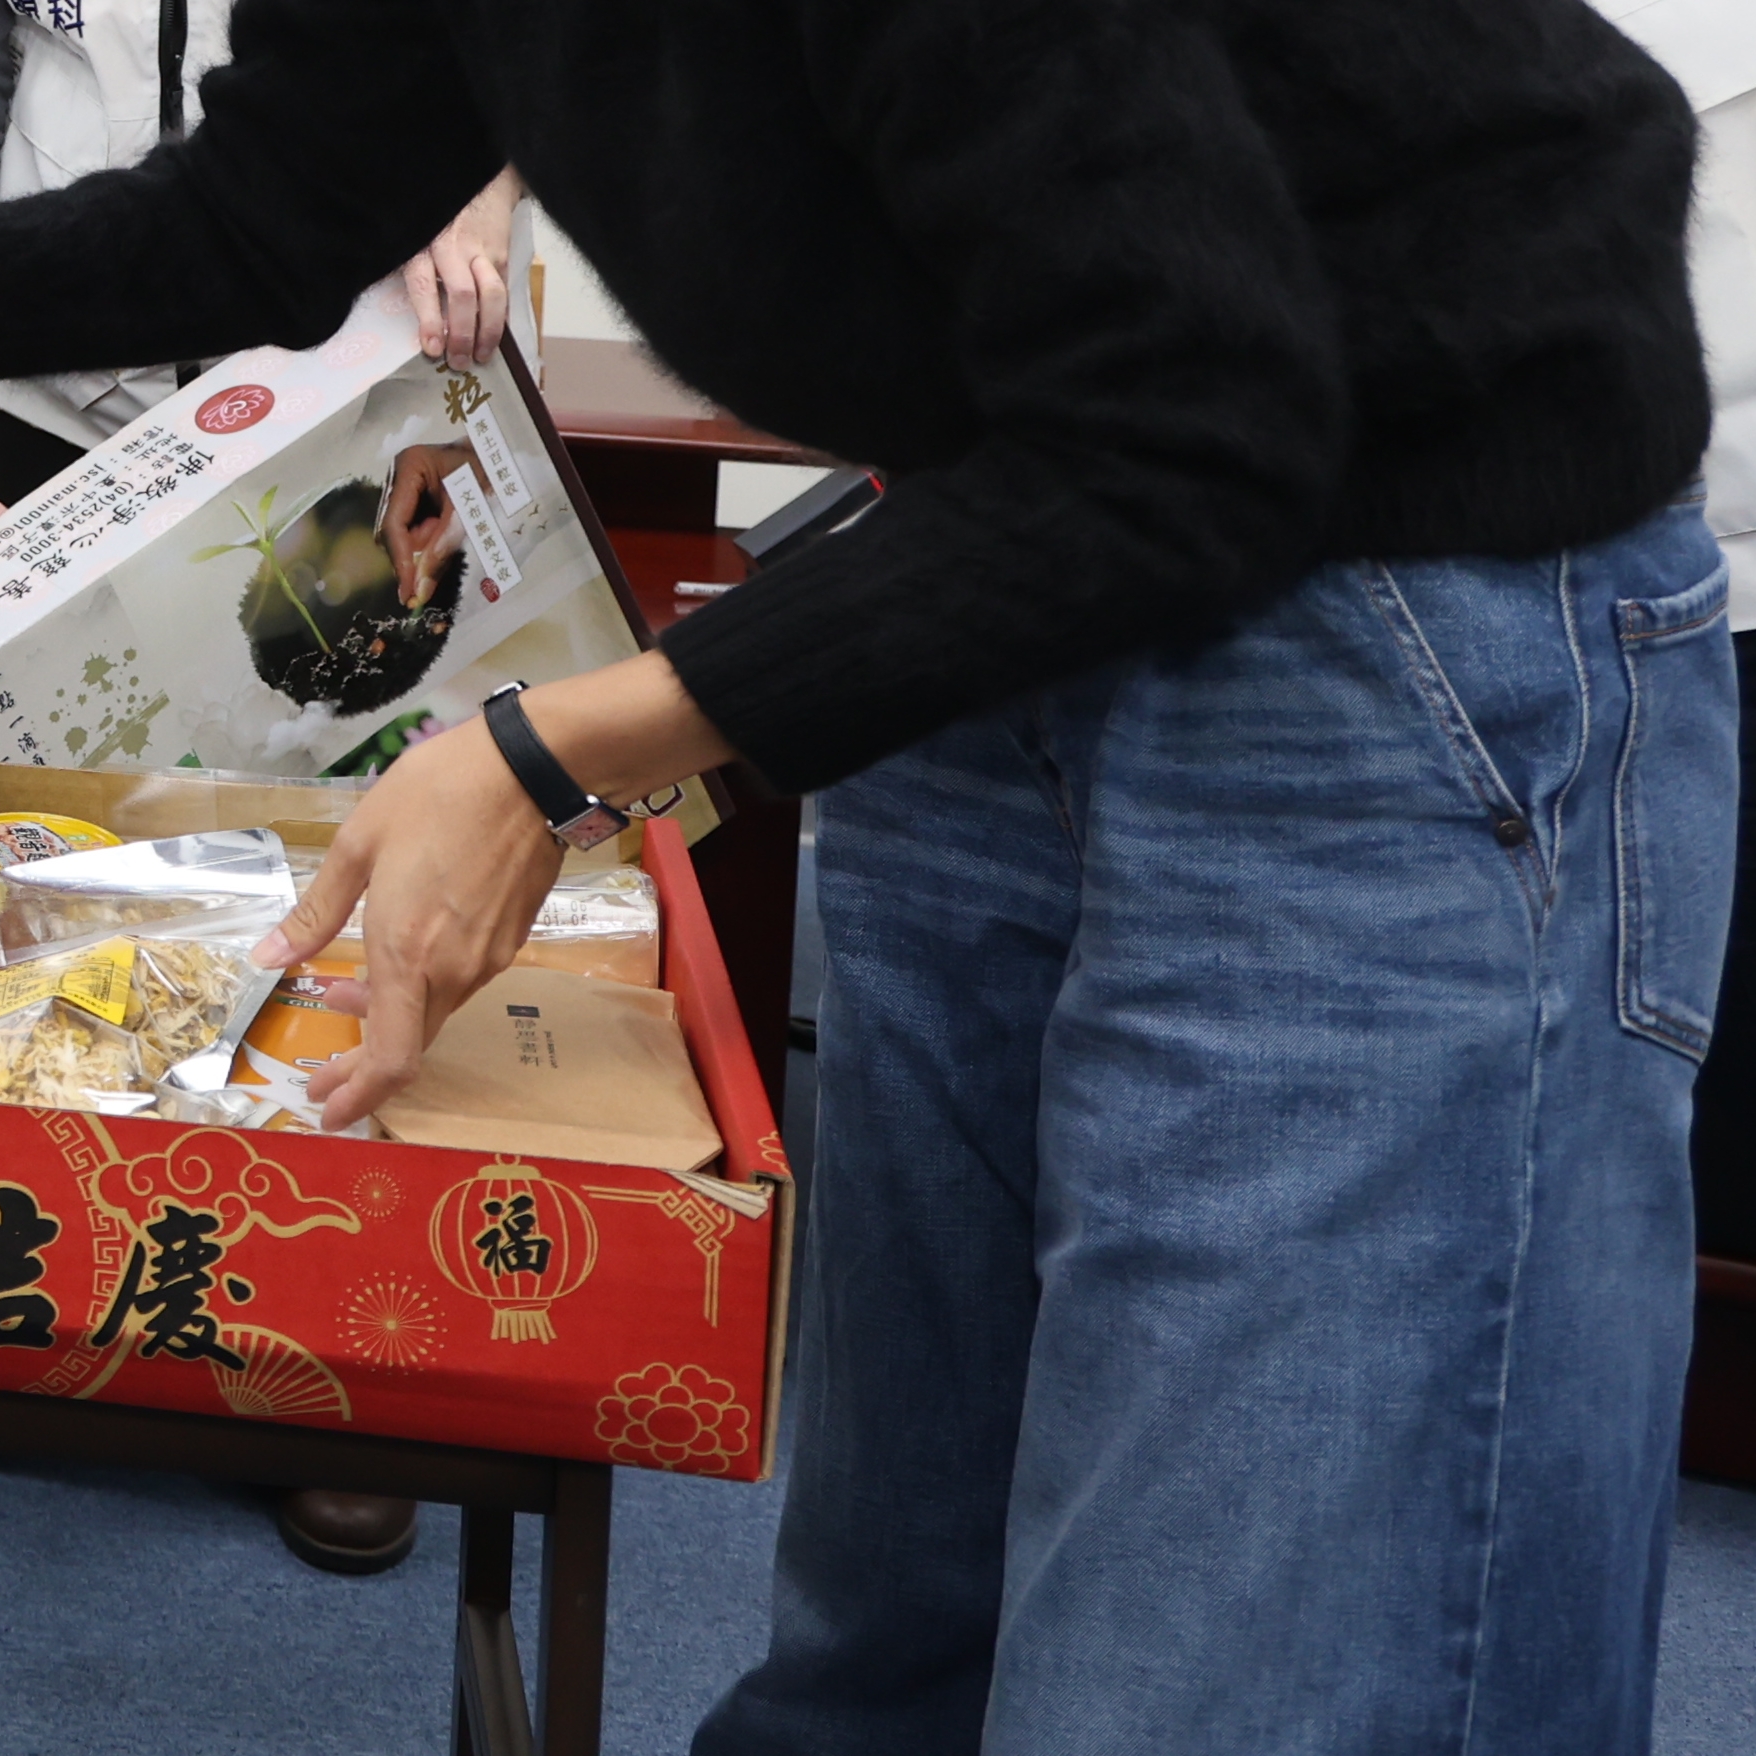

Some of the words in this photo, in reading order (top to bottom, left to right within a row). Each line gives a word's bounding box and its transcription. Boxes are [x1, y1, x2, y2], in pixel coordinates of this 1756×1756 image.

[436, 361, 493, 424] 粒
[473, 418, 520, 499] 落土百粒收
[474, 1193, 552, 1278] 福
